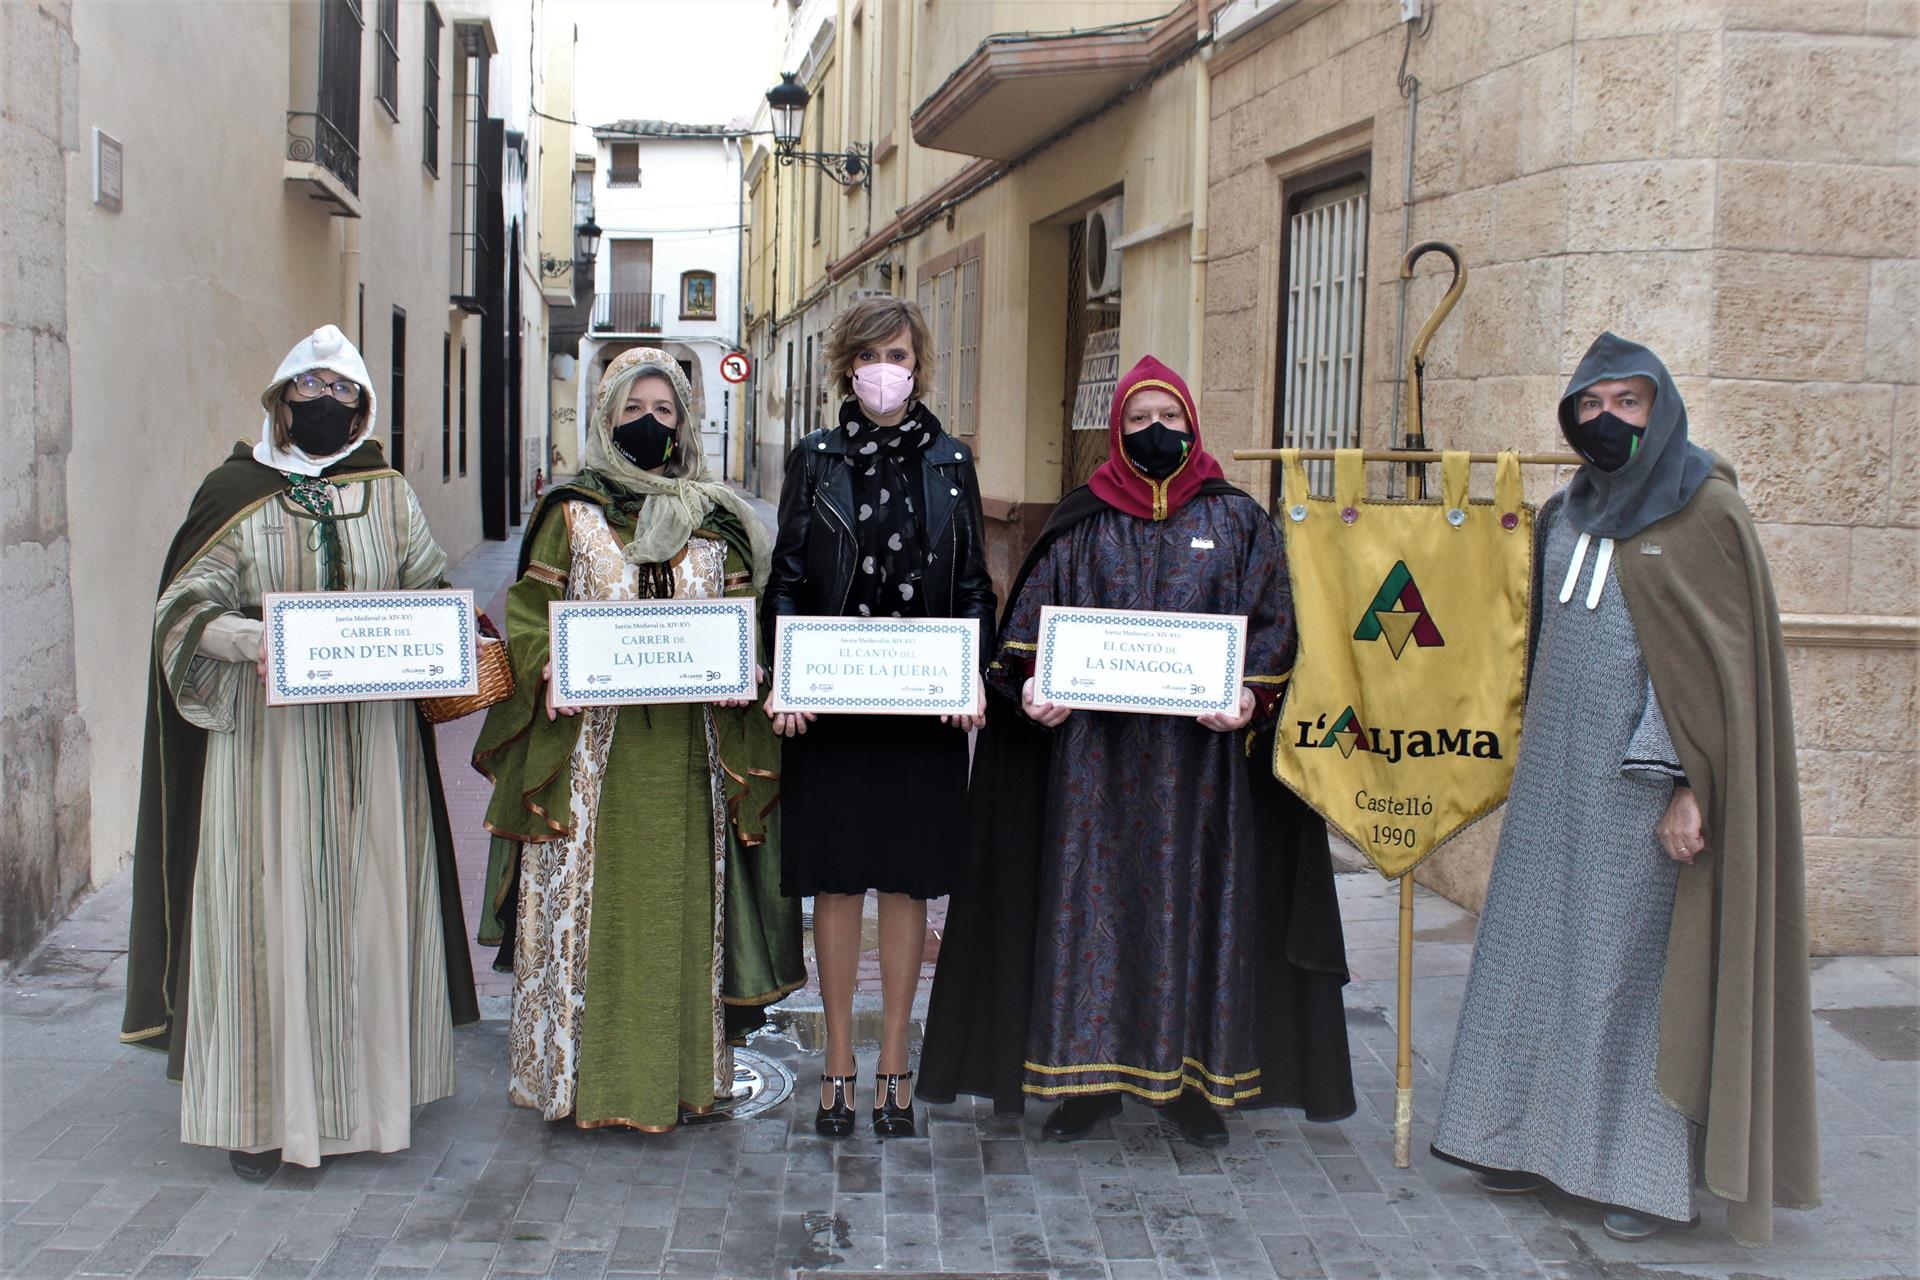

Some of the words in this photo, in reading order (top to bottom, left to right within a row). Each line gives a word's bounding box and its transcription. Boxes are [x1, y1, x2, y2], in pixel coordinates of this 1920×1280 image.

[1080, 356, 1118, 382] ALQUILA
[341, 627, 392, 638] CARRER
[394, 628, 413, 637] DEL
[621, 634, 670, 645] CARRER
[673, 636, 686, 644] DE
[309, 646, 356, 661] FORN
[360, 644, 398, 659] D'EN
[402, 643, 444, 657] REUS
[839, 648, 854, 657] EL
[855, 647, 897, 658] CANTÓ
[1103, 641, 1118, 651] EL
[1119, 642, 1163, 653] CANTÓ
[1165, 646, 1178, 654] DE
[613, 653, 634, 665] LA
[637, 650, 695, 667] JUERIA
[1085, 657, 1105, 670] LA
[1109, 658, 1194, 675] SINAGOGA
[806, 663, 839, 675] POU
[843, 663, 865, 675] DE
[869, 664, 888, 676] LA
[893, 664, 948, 678] JUERIA
[1355, 789, 1434, 816] Castelló
[1371, 823, 1416, 848] 1990
